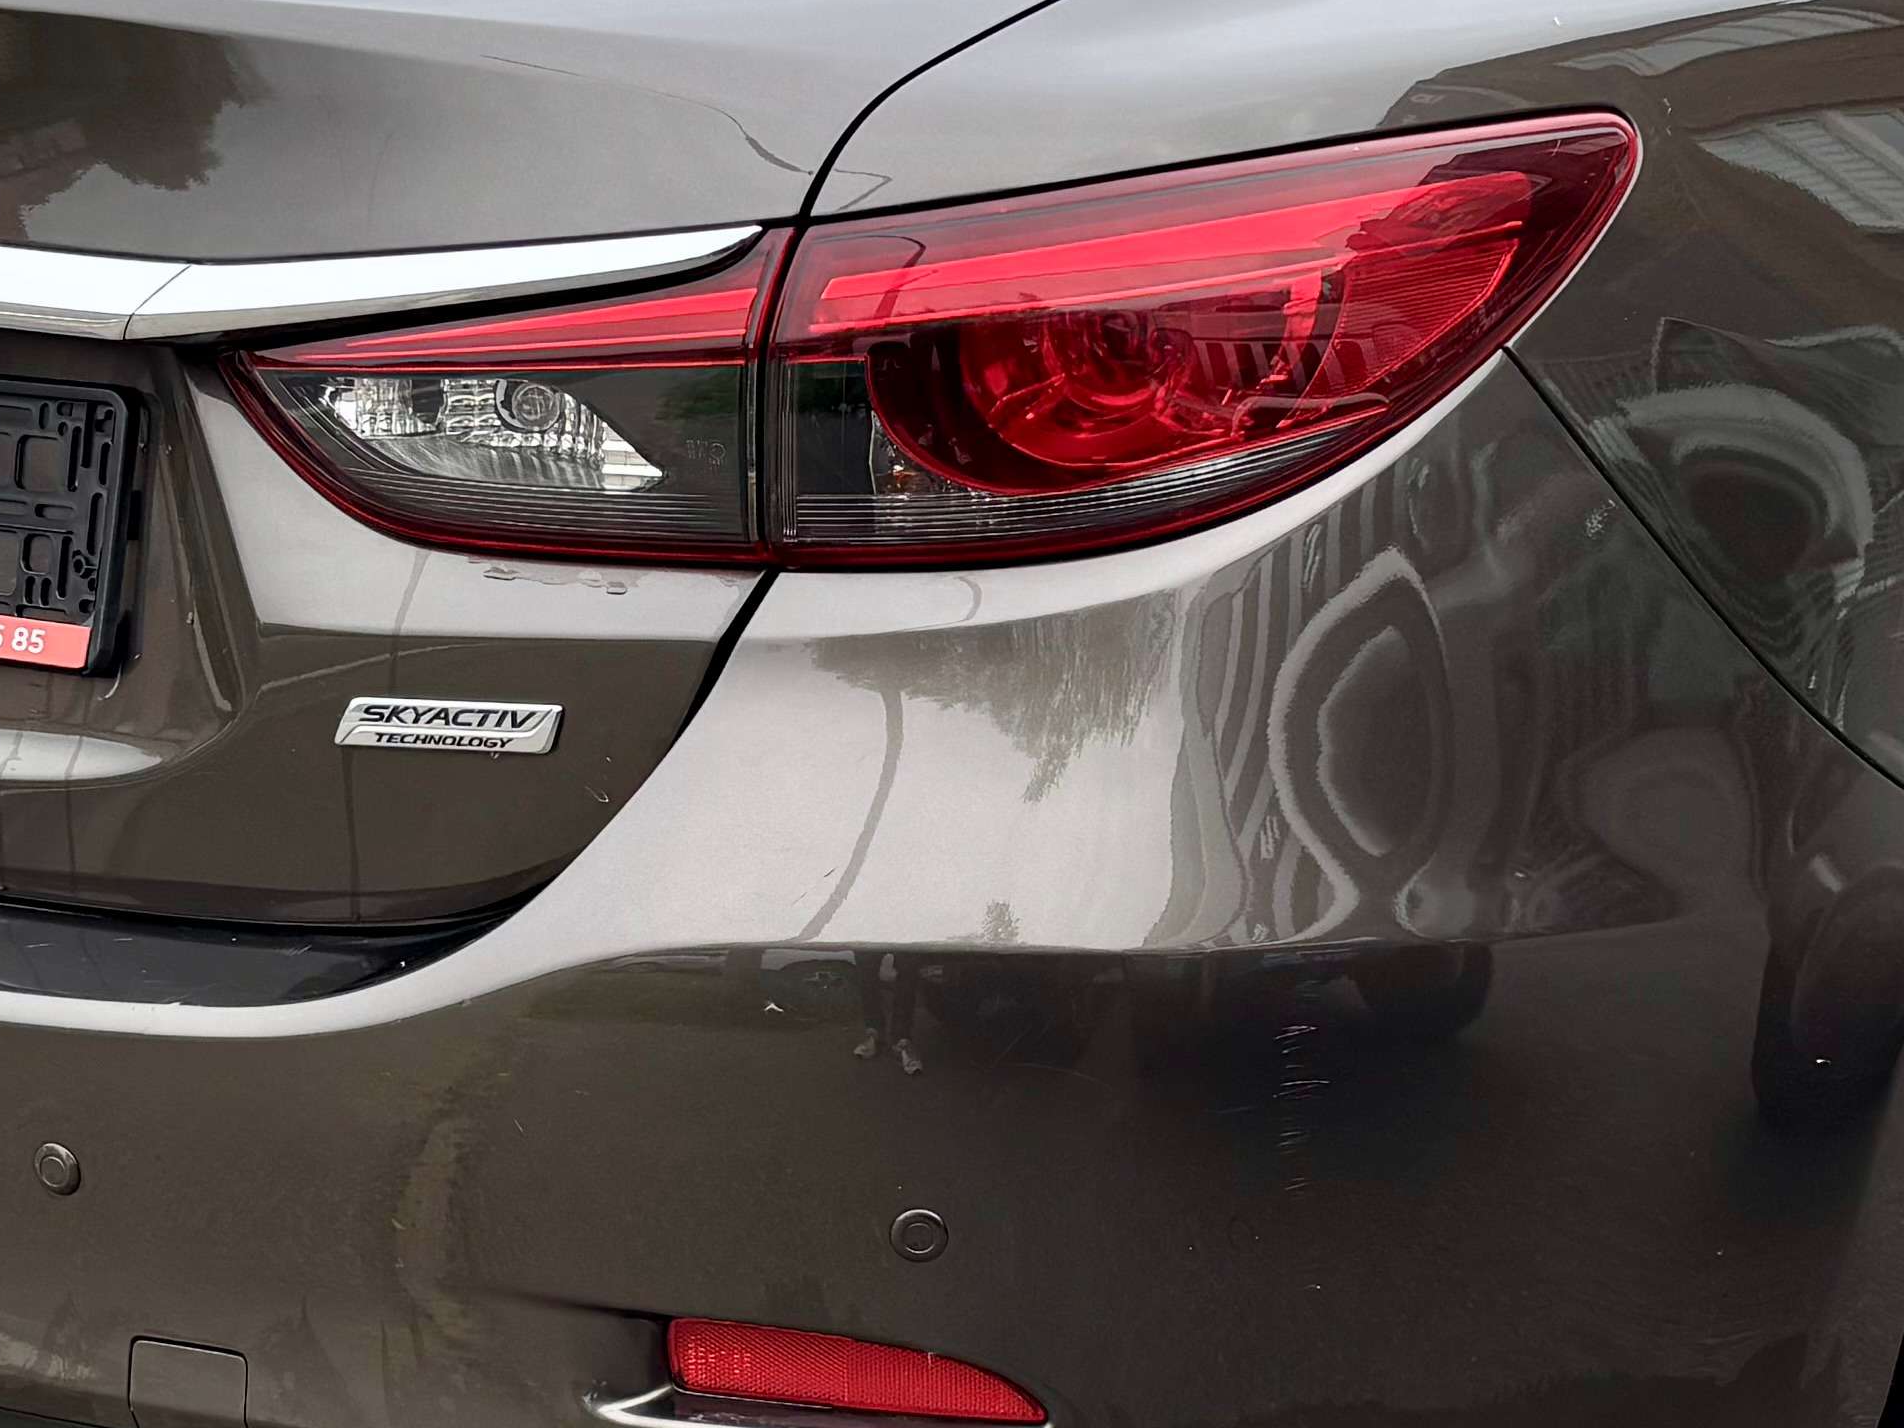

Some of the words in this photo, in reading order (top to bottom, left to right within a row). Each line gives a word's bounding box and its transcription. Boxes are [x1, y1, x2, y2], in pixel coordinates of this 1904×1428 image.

[11, 626, 46, 654] 85
[359, 704, 537, 729] SKYACTIV
[374, 732, 514, 749] TECHNOLOGY
